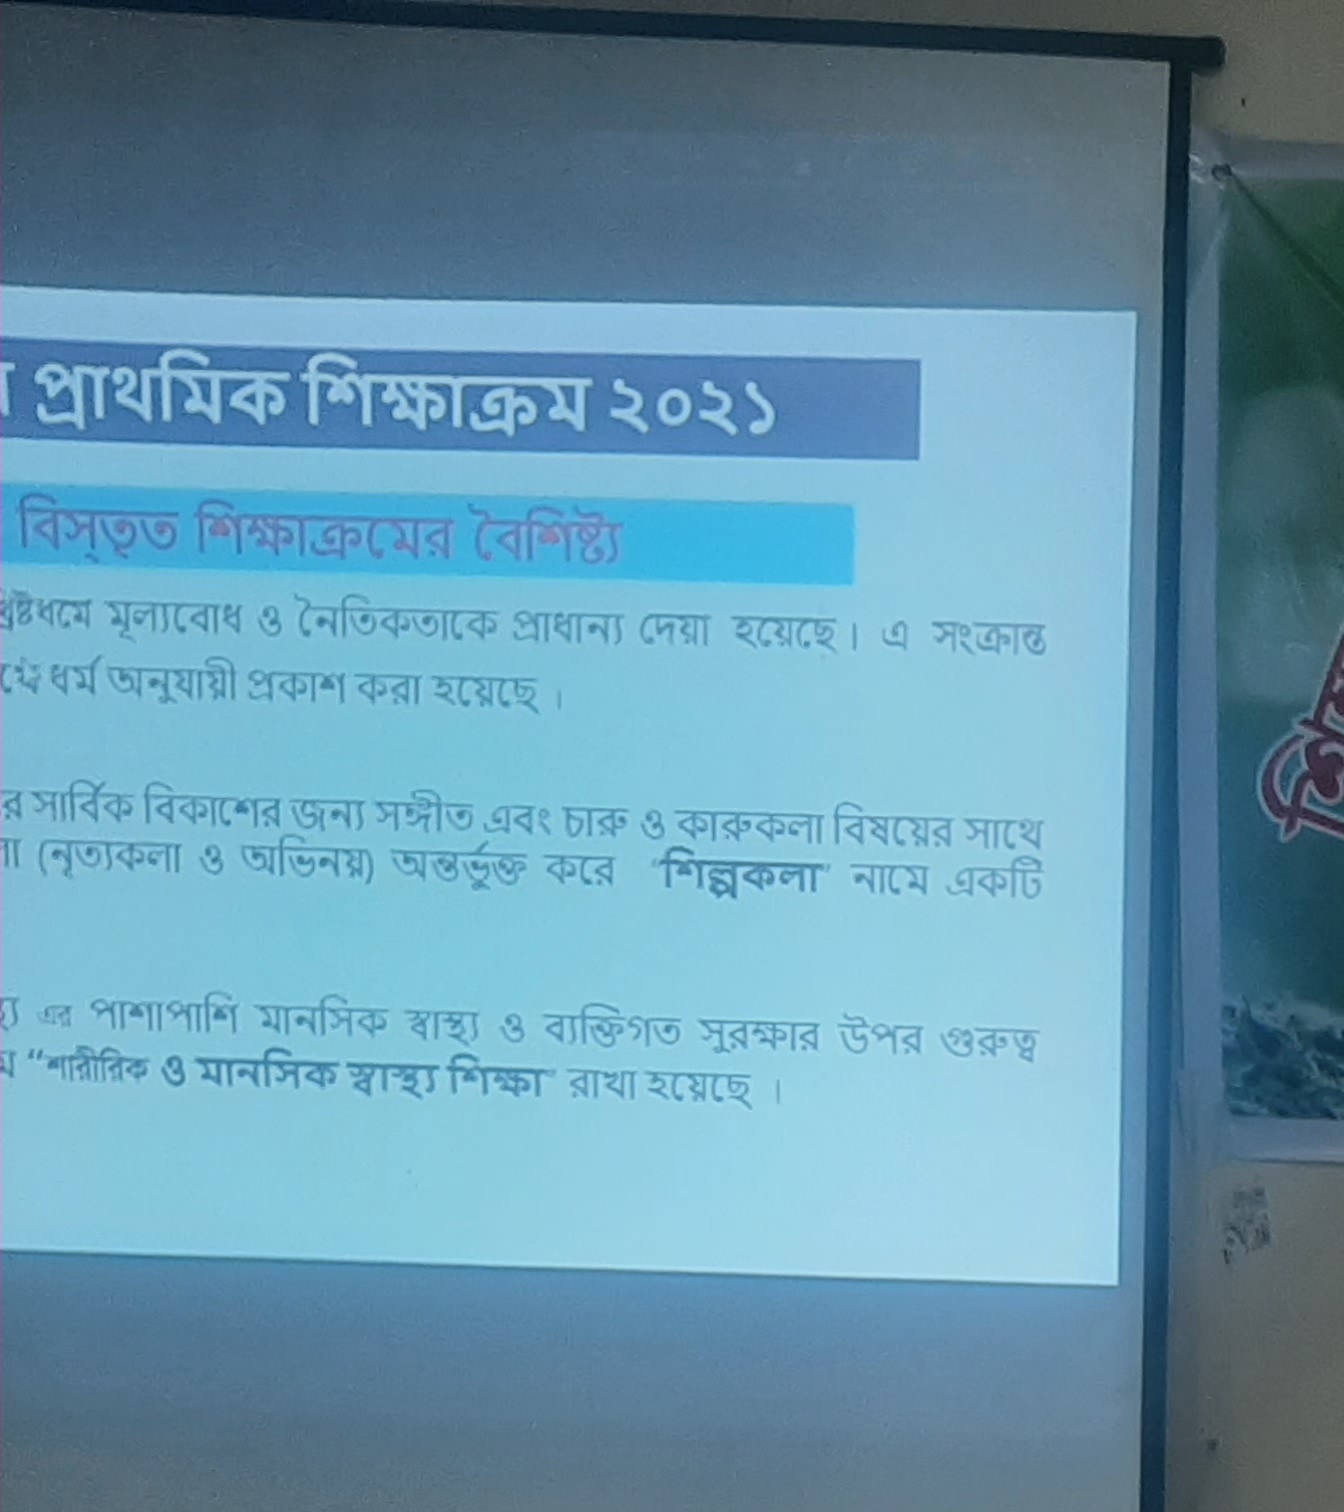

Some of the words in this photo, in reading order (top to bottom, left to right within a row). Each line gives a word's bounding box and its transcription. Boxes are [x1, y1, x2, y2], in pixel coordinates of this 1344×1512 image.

[34, 348, 292, 431] প্রাথমিক
[300, 352, 594, 437] শিক্ষাক্রম
[609, 377, 777, 437] ২০২১
[195, 498, 454, 562] শিক্ষাক্রমের
[467, 502, 624, 564] বৈশিষ্ট্য
[104, 600, 243, 643] মূল্যবোধ
[258, 604, 282, 637] ও
[294, 592, 498, 641] নৈতিকতাকে
[513, 608, 624, 646] প্রাধান্য
[639, 612, 712, 647] দেয়া
[881, 620, 910, 651] এ
[930, 620, 1047, 657] সংক্রান্ত
[51, 654, 104, 696] ধর্ম
[107, 655, 237, 704] অনুযায়ী
[248, 668, 346, 704] প্রকাশ
[354, 673, 422, 705] করা
[31, 779, 134, 823] সার্বিক
[143, 781, 282, 829] বিকাশের
[290, 799, 365, 832] জন্য
[375, 788, 474, 833] সঙ্গীত
[483, 804, 552, 836] এবং
[561, 806, 630, 839] চারু
[640, 809, 665, 840] ও
[674, 810, 824, 845] কারুকলা
[832, 801, 955, 848] বিষয়ের
[962, 818, 1045, 850] সাথে
[199, 843, 225, 876] ও
[543, 854, 617, 887] করে
[849, 863, 930, 896] নামে
[945, 855, 1045, 900] একটি
[90, 990, 241, 1035] পাশাপাশি
[253, 993, 390, 1039] মানসিক
[403, 1008, 480, 1047] স্বাস্থ্য
[501, 1012, 526, 1043] ও
[542, 1002, 682, 1048] ব্যক্তিগত
[697, 1018, 821, 1055] সুরক্ষার
[837, 1012, 924, 1055] উপর
[940, 1024, 1041, 1064] গুরুত্ব
[161, 1055, 187, 1088] ও
[194, 1047, 340, 1090] মানসিক
[346, 1062, 441, 1100] স্বাস্থ্য
[567, 1067, 638, 1100] রাখা
